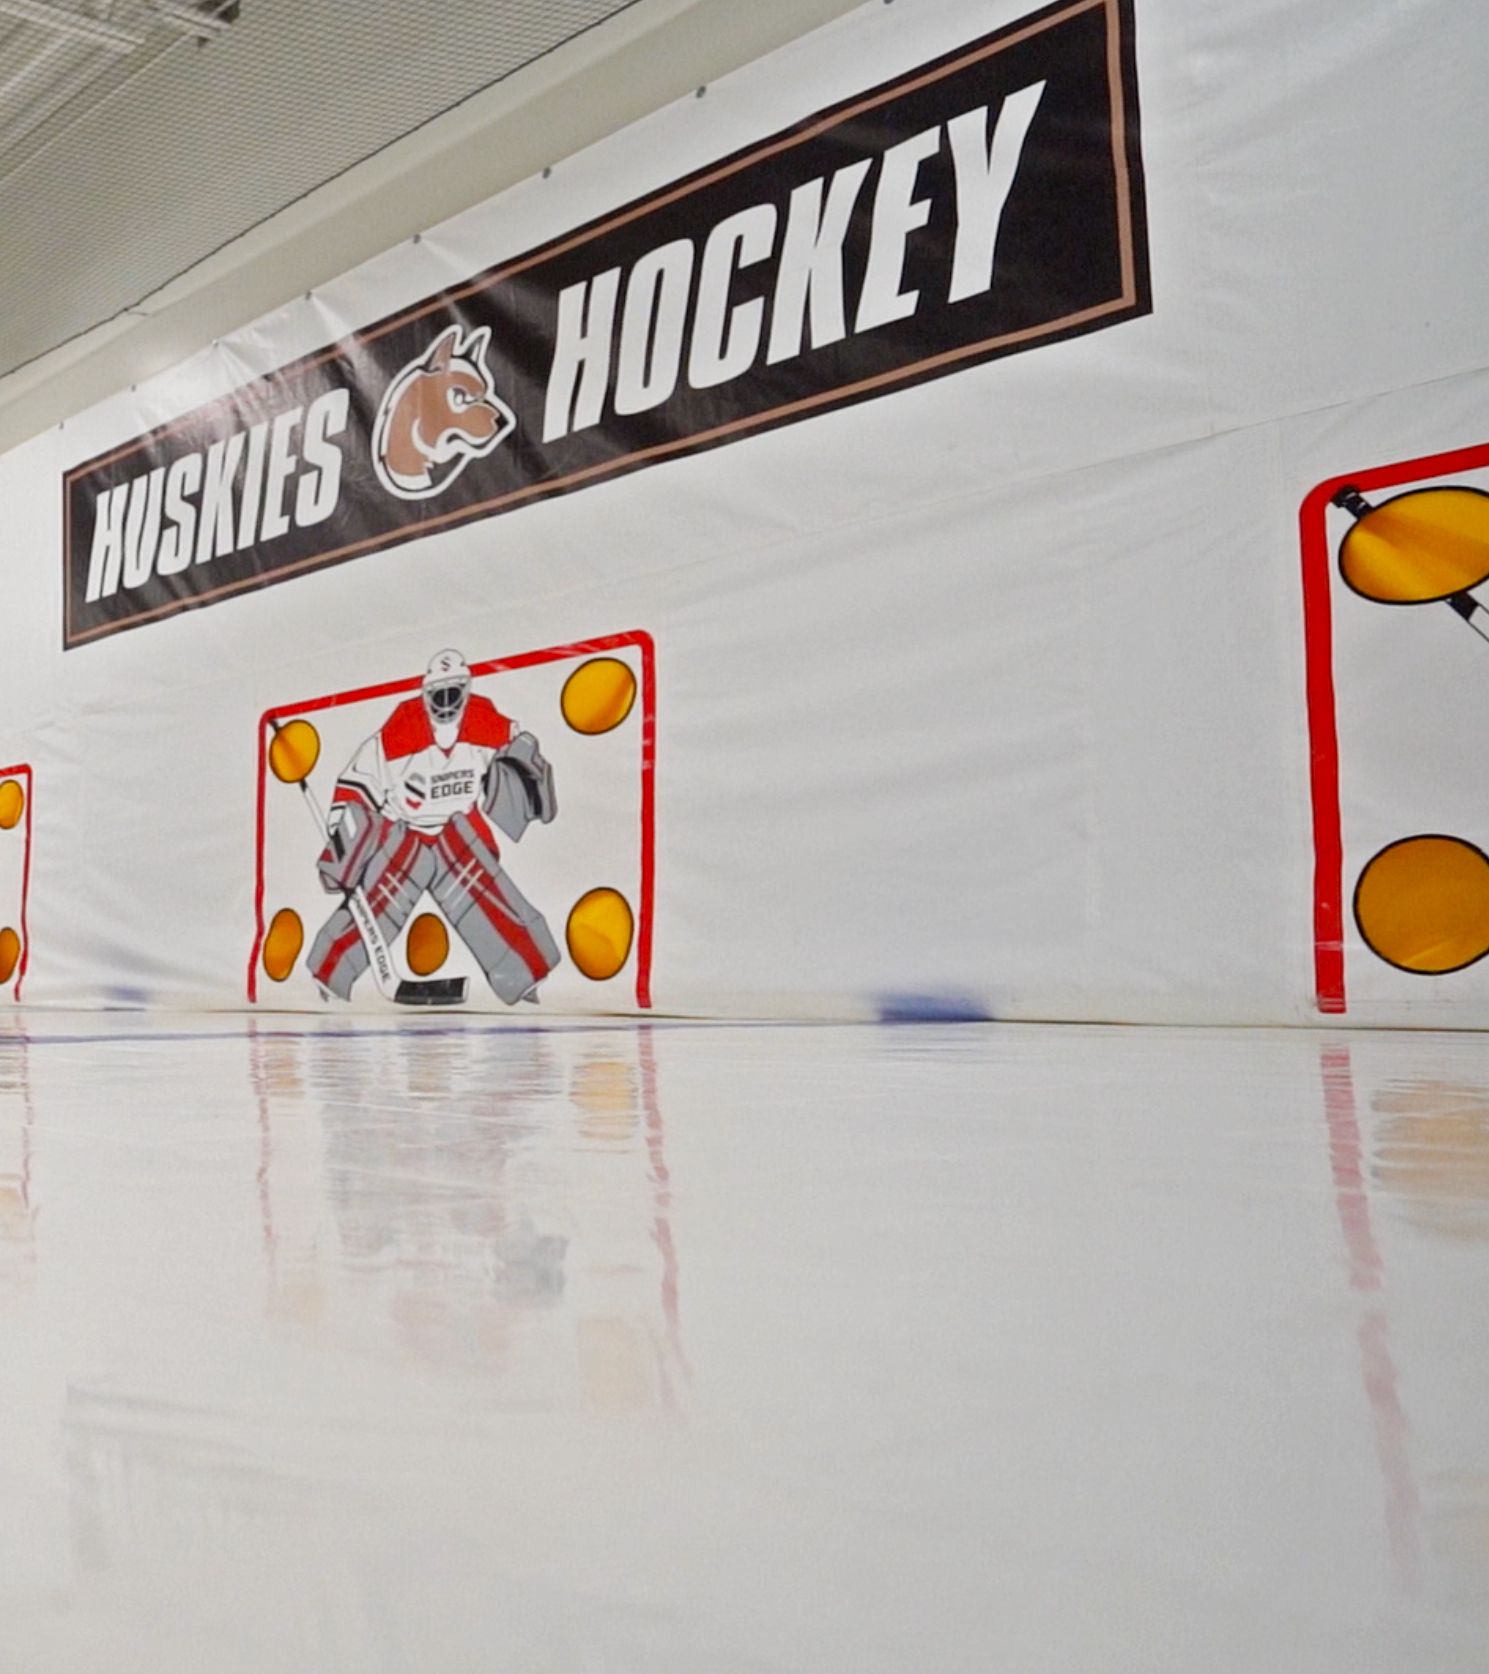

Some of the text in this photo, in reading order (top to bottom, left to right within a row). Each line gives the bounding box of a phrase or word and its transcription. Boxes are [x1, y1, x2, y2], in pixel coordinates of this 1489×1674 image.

[85, 79, 1046, 603] HUSKIES HOCKEY
[431, 769, 475, 784] SNIPERS
[431, 780, 473, 799] EDGE
[375, 945, 390, 984] EDGE
